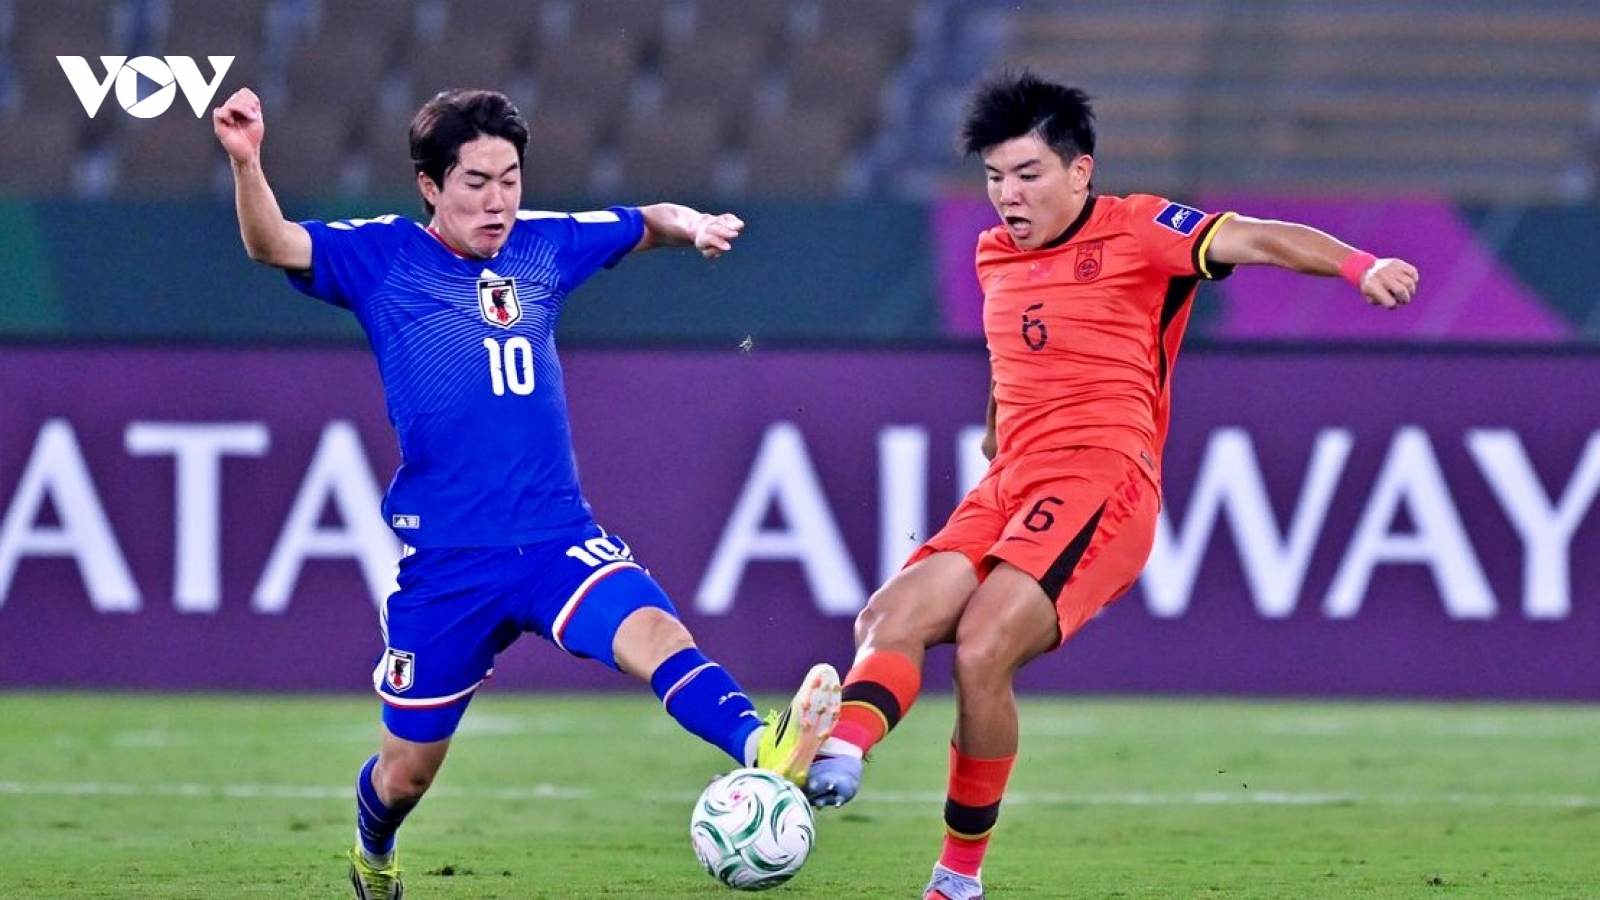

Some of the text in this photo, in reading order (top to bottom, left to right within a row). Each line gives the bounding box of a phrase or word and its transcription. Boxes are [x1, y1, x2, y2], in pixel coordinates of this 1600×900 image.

[1022, 303, 1047, 351] 6
[483, 337, 535, 396] 10
[695, 422, 1600, 619] AIWAY
[1023, 496, 1064, 532] 6
[566, 538, 628, 566] 10
